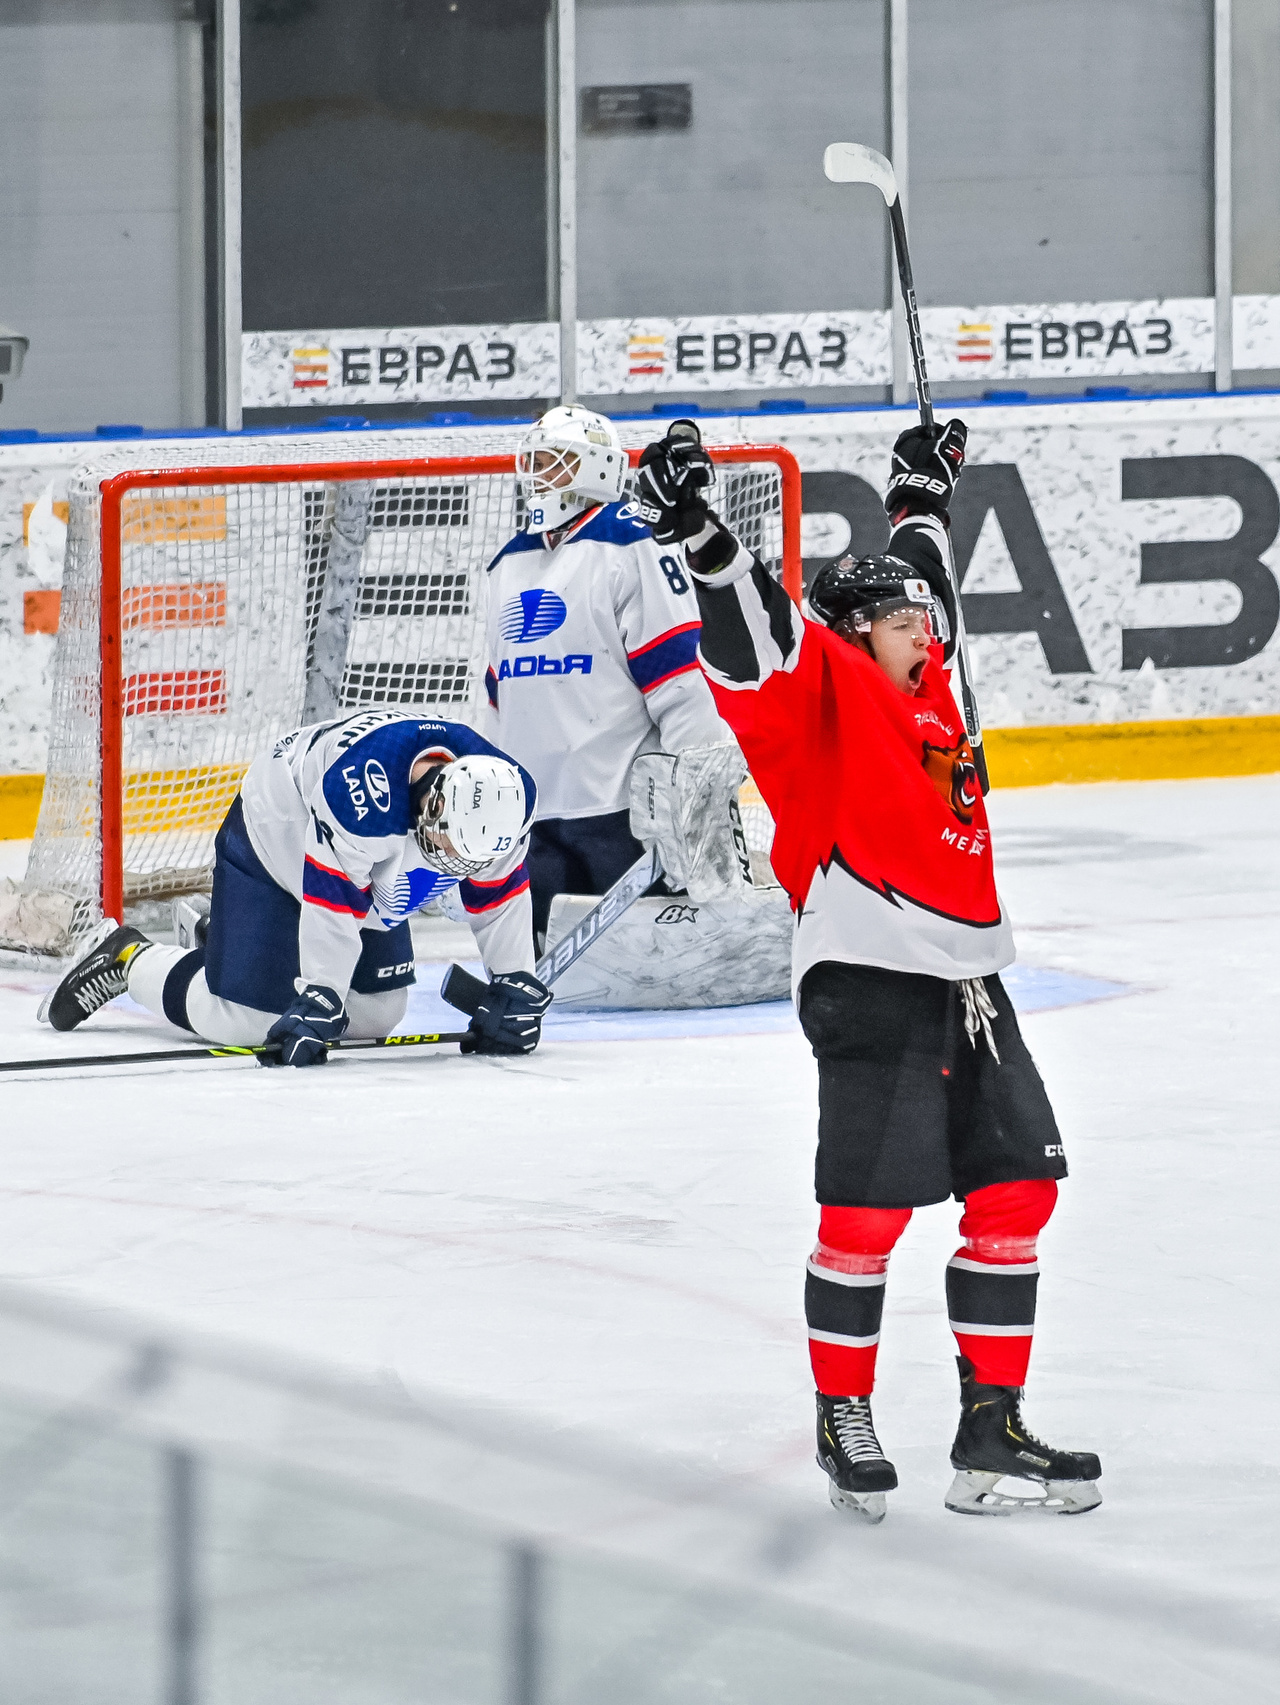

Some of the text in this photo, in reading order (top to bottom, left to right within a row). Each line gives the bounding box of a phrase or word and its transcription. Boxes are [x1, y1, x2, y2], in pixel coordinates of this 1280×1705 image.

[675, 327, 848, 374] ЕВРАЗ
[1004, 318, 1173, 362] ЕВРАЗ
[341, 342, 517, 386] ЕВРАЗ
[658, 554, 692, 596] 8
[341, 765, 370, 822] LADA
[472, 780, 484, 810] LADA
[492, 836, 512, 852] 13
